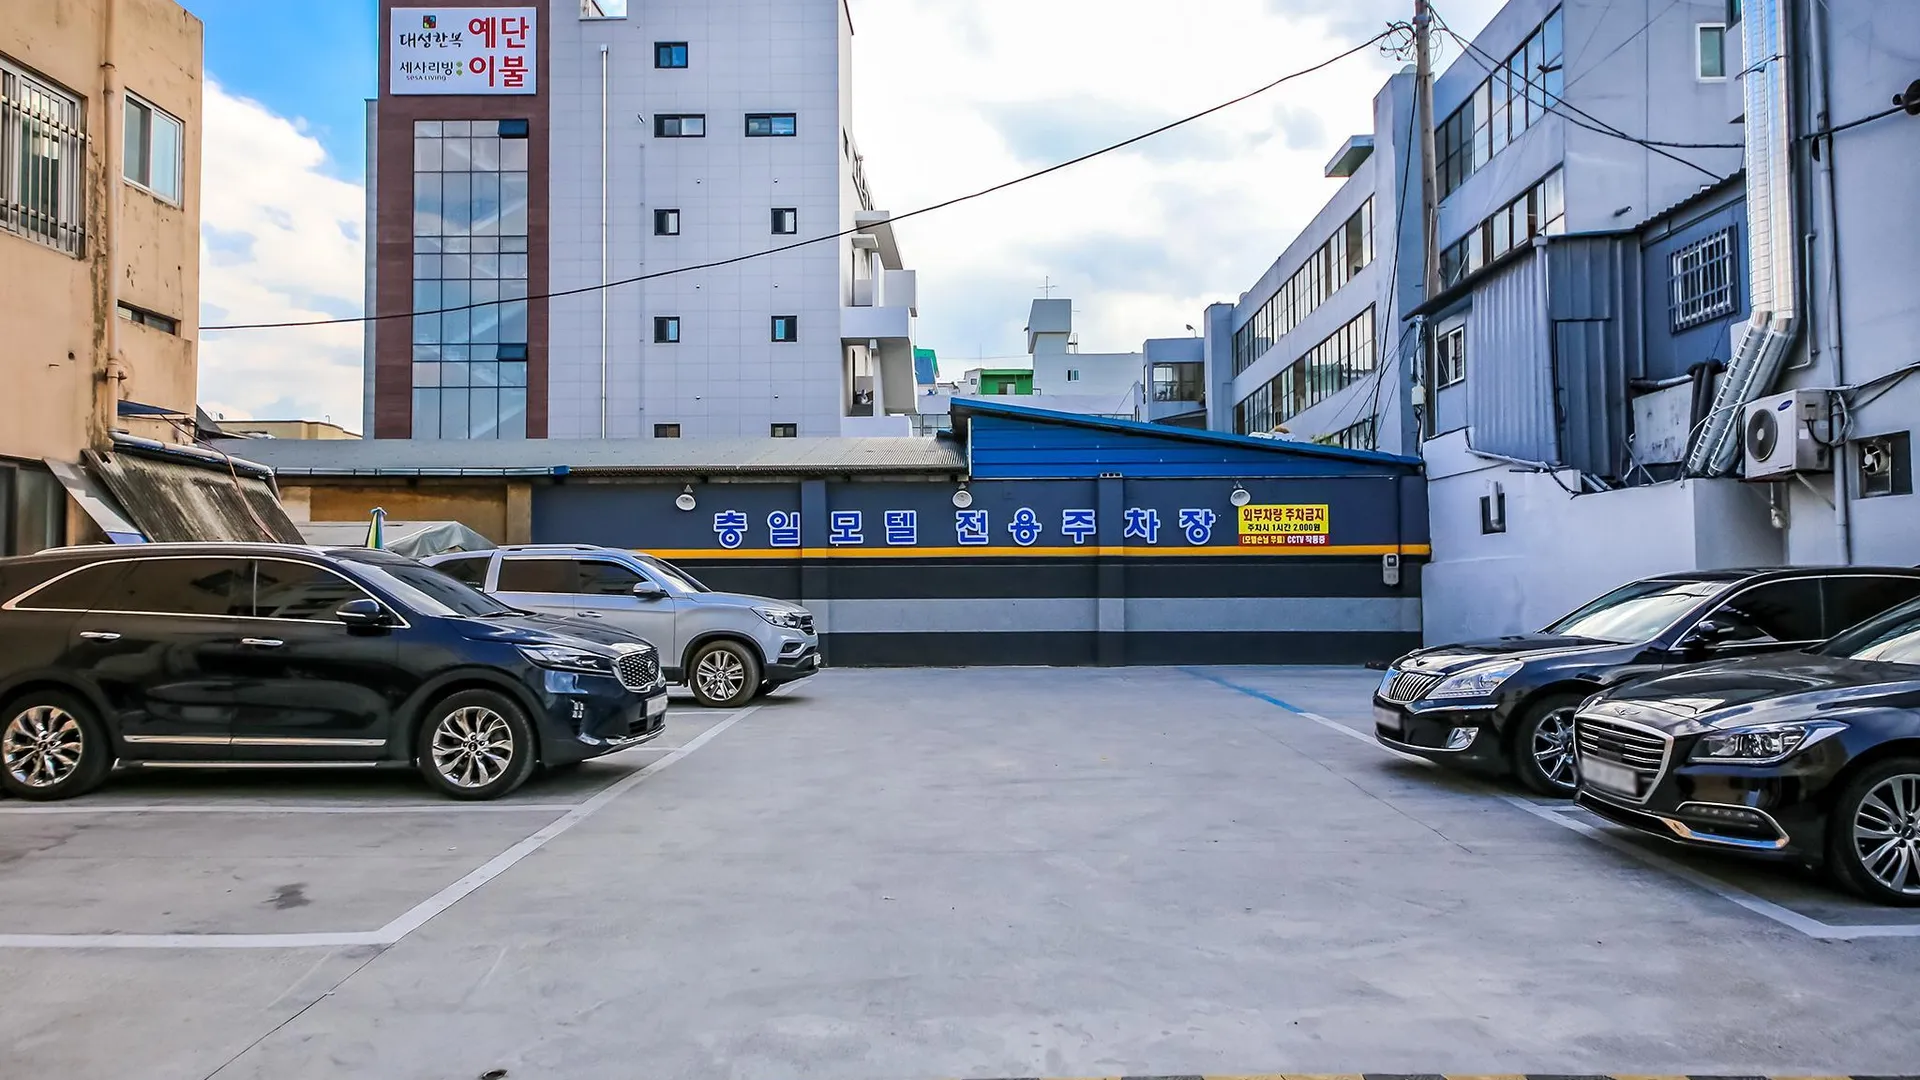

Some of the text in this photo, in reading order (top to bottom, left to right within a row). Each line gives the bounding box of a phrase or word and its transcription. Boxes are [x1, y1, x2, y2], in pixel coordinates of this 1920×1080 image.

[399, 31, 464, 49] 대성한복
[468, 16, 530, 49] 예단
[400, 61, 453, 76] 세사리빙
[468, 55, 529, 88] 이불
[1243, 508, 1324, 522] 외부차량 주차금지
[1272, 523, 1291, 532] 1시간
[1287, 535, 1305, 544] CCTV
